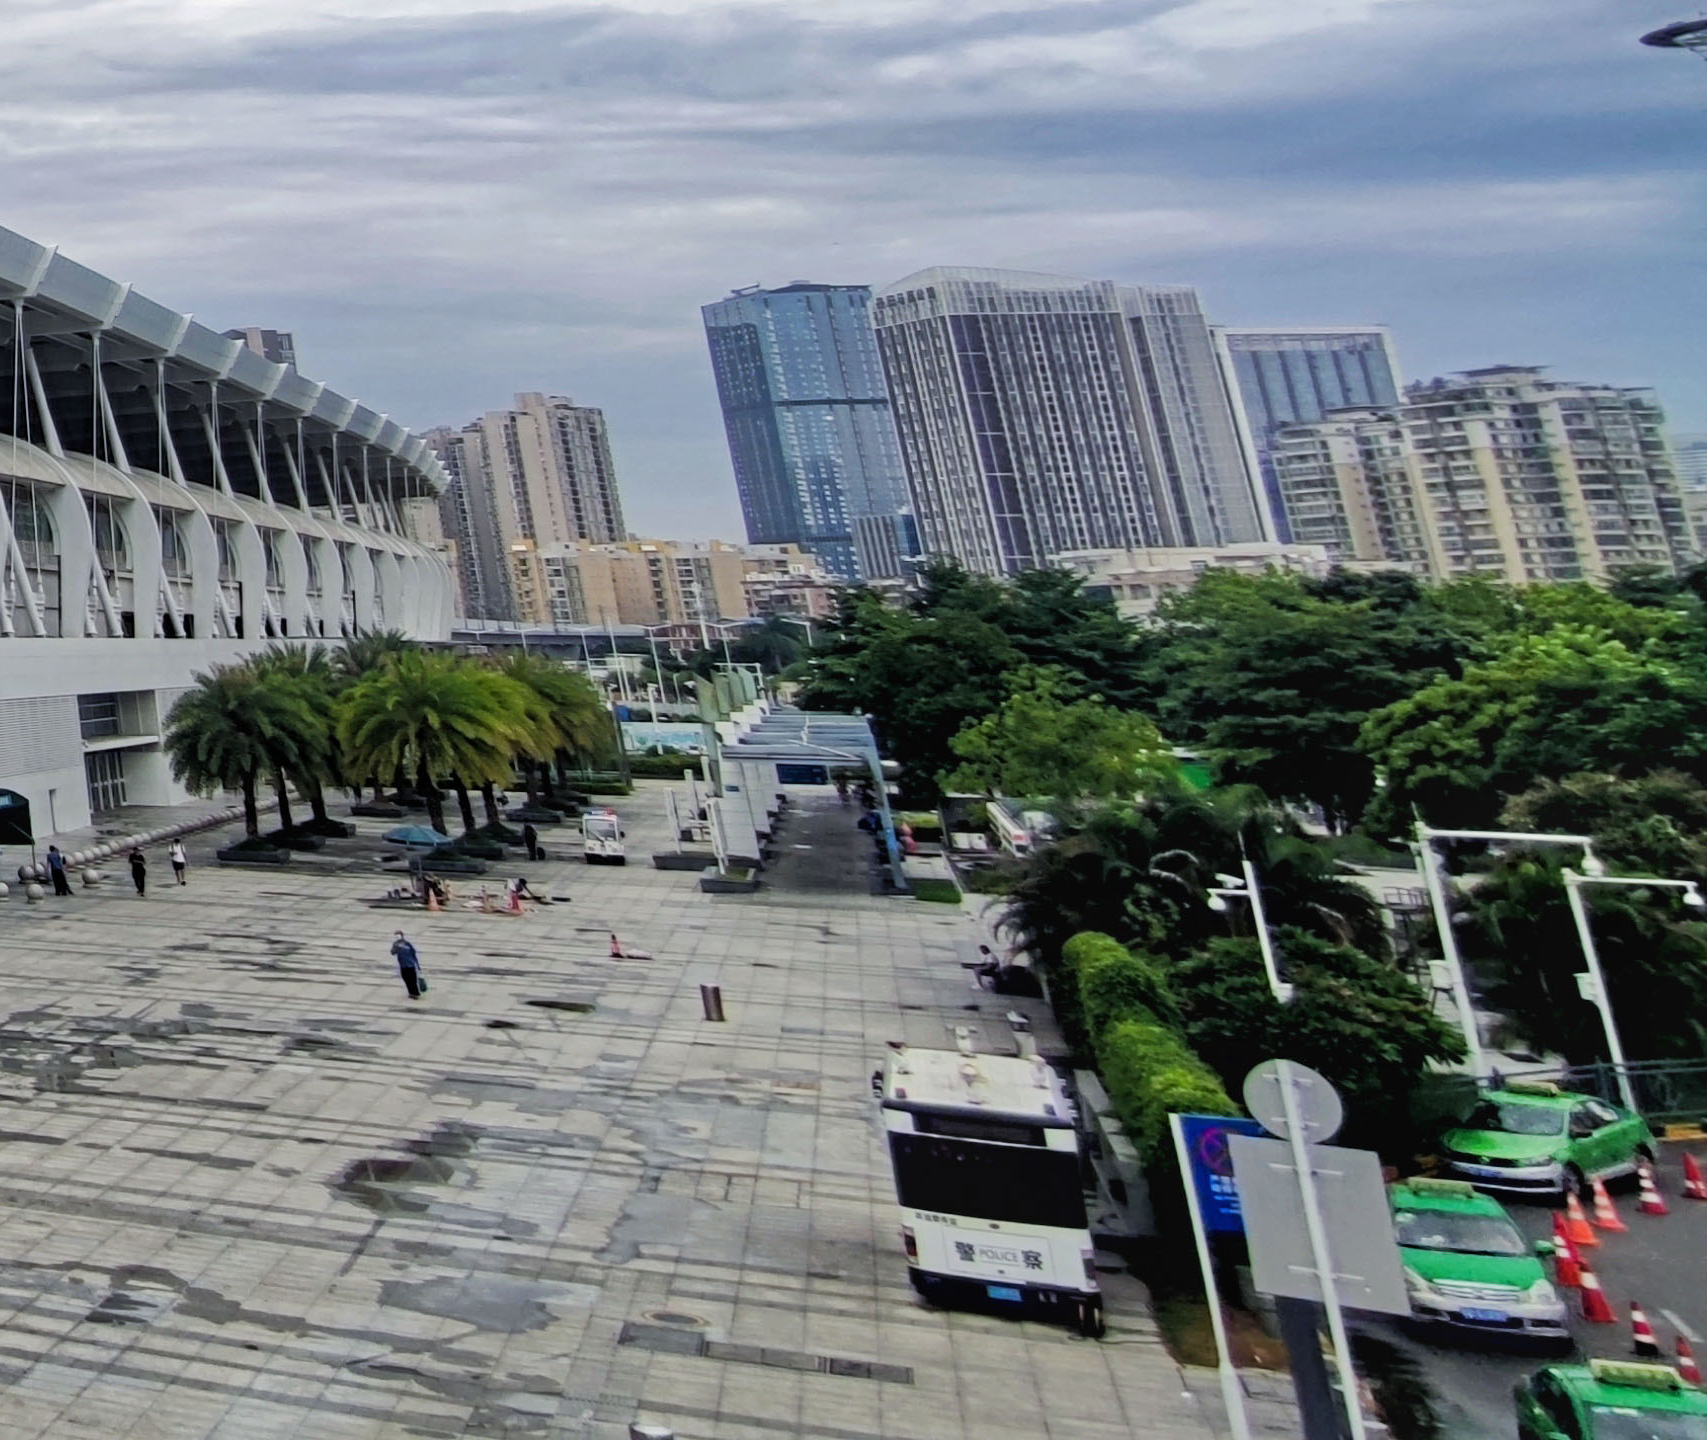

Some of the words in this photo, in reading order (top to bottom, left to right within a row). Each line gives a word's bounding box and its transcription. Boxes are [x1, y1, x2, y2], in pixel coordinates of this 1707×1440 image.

[955, 1241, 975, 1262] 警
[978, 1248, 1018, 1263] POLICE
[1021, 1250, 1043, 1270] 察
